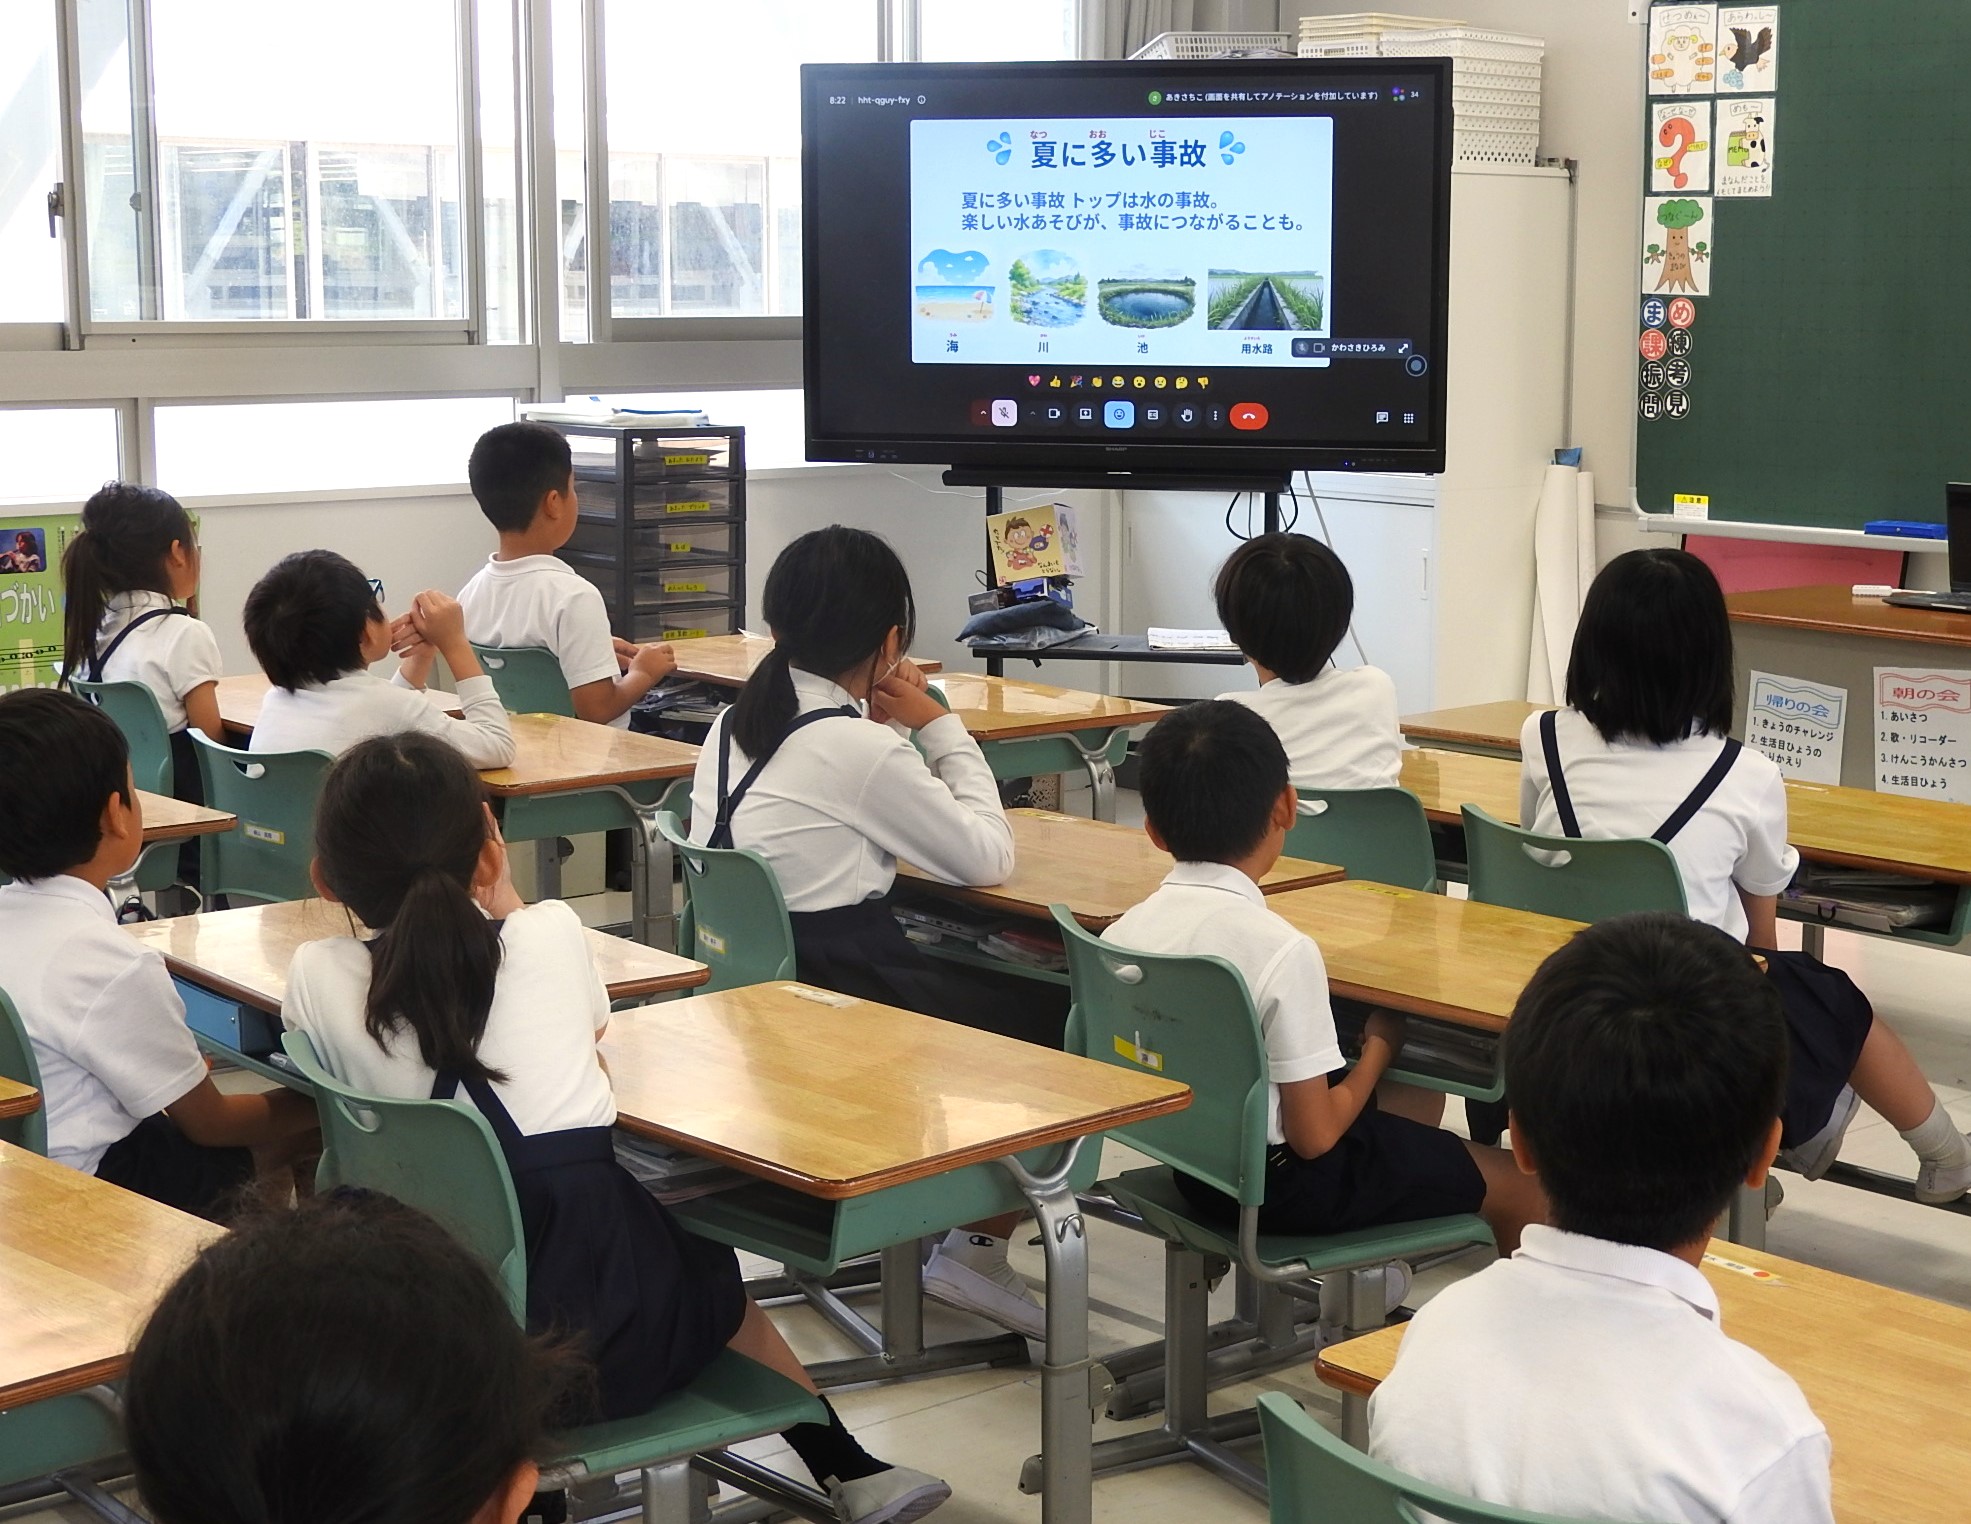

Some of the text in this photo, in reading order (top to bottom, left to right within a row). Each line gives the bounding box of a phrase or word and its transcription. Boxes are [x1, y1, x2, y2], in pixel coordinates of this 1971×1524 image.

[829, 96, 911, 106] 8:22 hht-qguy-fxy
[1165, 91, 1378, 102] あきさちこ (画面を共有してアノテーションを付加しています)
[1030, 129, 1166, 139] なつ おお じこ
[1030, 139, 1207, 169] 夏に多い事故
[961, 191, 1218, 209] 夏に多い事故 トップは水の事故。
[961, 213, 1304, 231] 楽しい水あそびが、事故につながることも。
[1646, 302, 1662, 323] ま
[1673, 303, 1690, 323] め
[946, 340, 959, 353] 海
[1038, 341, 1049, 353] 川
[1137, 341, 1149, 353] 池
[1241, 343, 1273, 355] 用水路
[1331, 343, 1386, 352] かわさきひろみ
[1642, 332, 1664, 357] 課
[1668, 330, 1689, 355] 練
[1642, 363, 1663, 388] 振
[1668, 361, 1688, 386] 考
[1640, 393, 1662, 418] 問
[1666, 391, 1688, 416] 見
[0, 582, 55, 625] づかい
[1893, 687, 1961, 702] 朝の会
[1766, 694, 1830, 718] 帰りの会
[1891, 711, 1928, 723] あいさつ
[1762, 718, 1834, 742] きょうのチャレンジ
[1890, 732, 1957, 746] 歌・リコーダー
[1760, 736, 1822, 758] 生活目ひょうの
[1760, 750, 1802, 768] りかえり
[1891, 754, 1967, 768] けんこうかんさつ
[1891, 775, 1947, 789] 生活目ひょう
